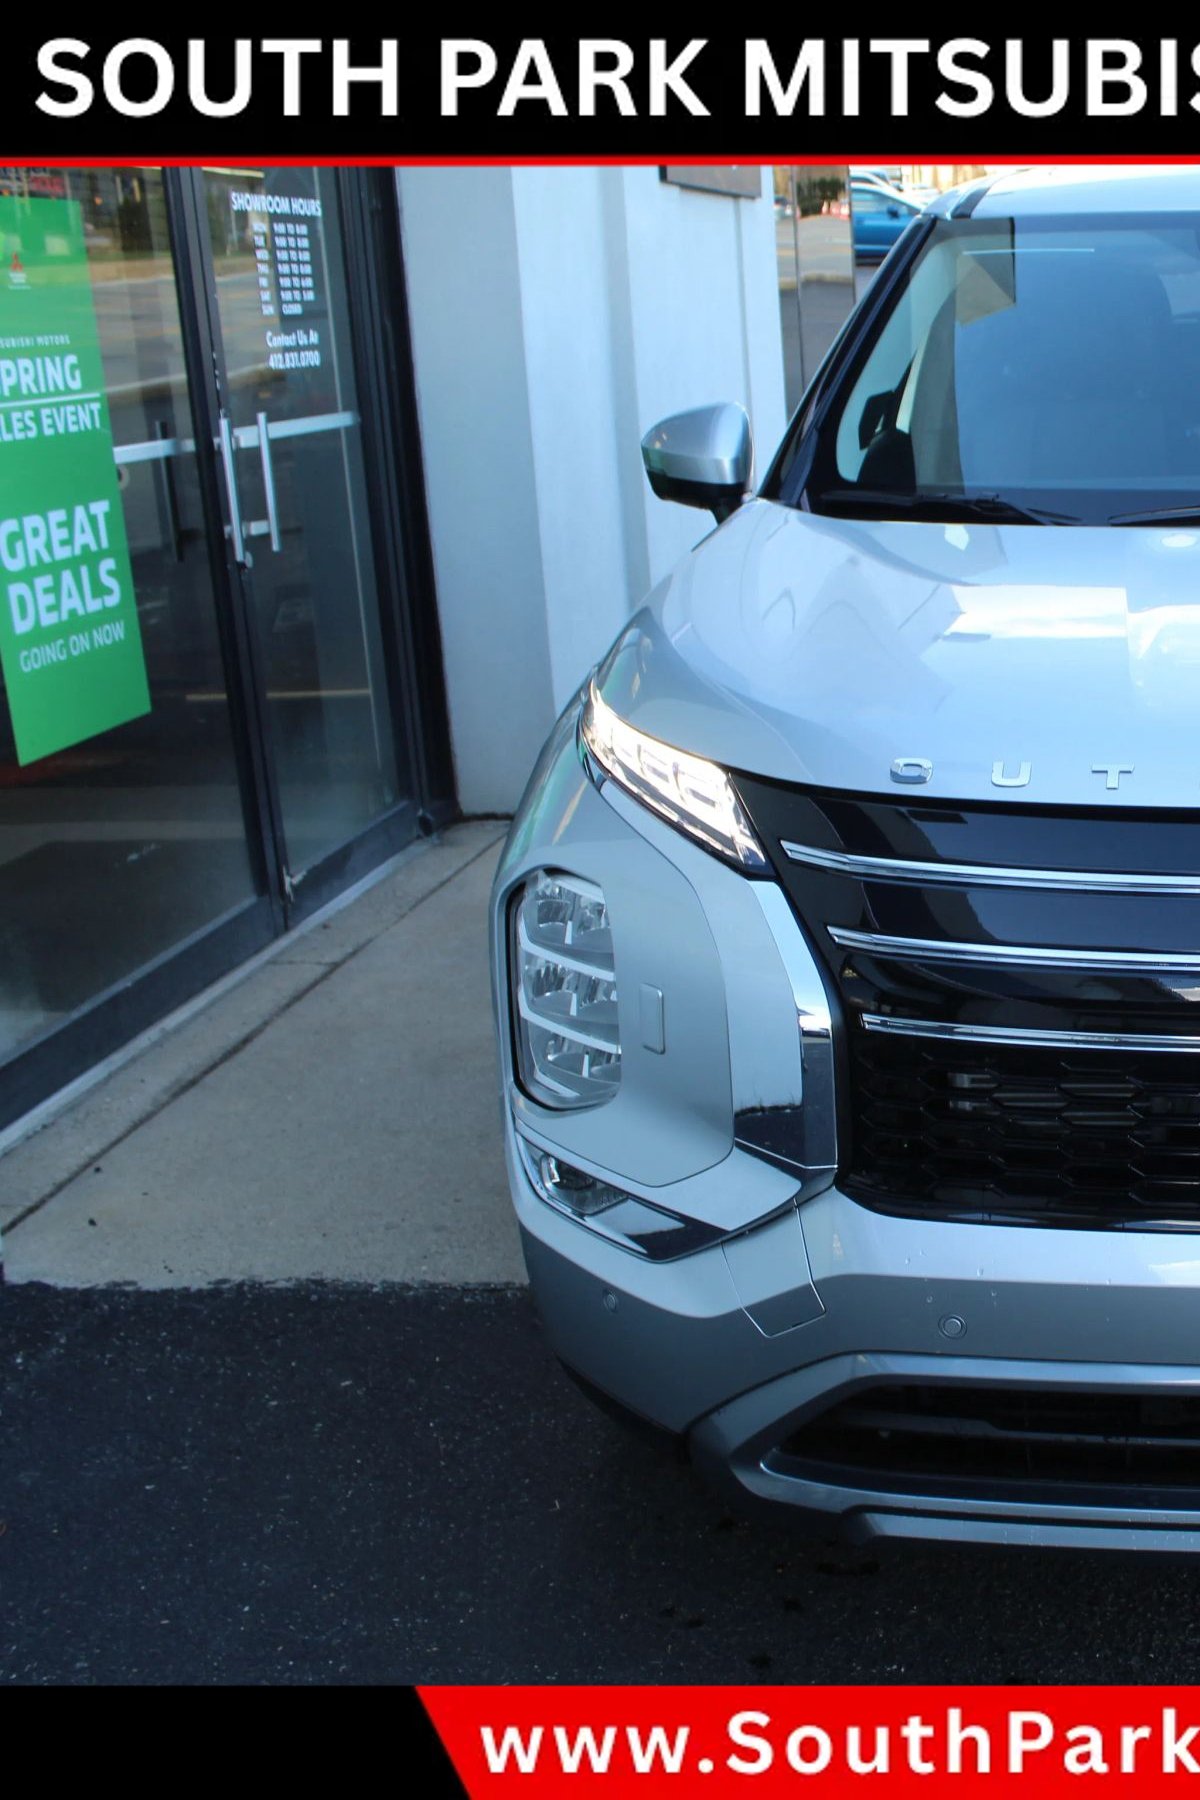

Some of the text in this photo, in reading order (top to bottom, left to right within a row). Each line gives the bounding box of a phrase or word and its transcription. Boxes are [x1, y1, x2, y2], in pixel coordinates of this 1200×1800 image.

[231, 192, 321, 217] SHOWROOM HOURS
[36, 335, 71, 347] MOTORS
[266, 328, 320, 348] Contact Us At
[0, 354, 82, 397] PRING
[268, 350, 321, 370] 412.831.0700
[0, 402, 101, 442] LES EVENT
[0, 500, 111, 573] GREAT
[8, 557, 121, 635] DEALS
[19, 621, 125, 673] GOING ON NOW
